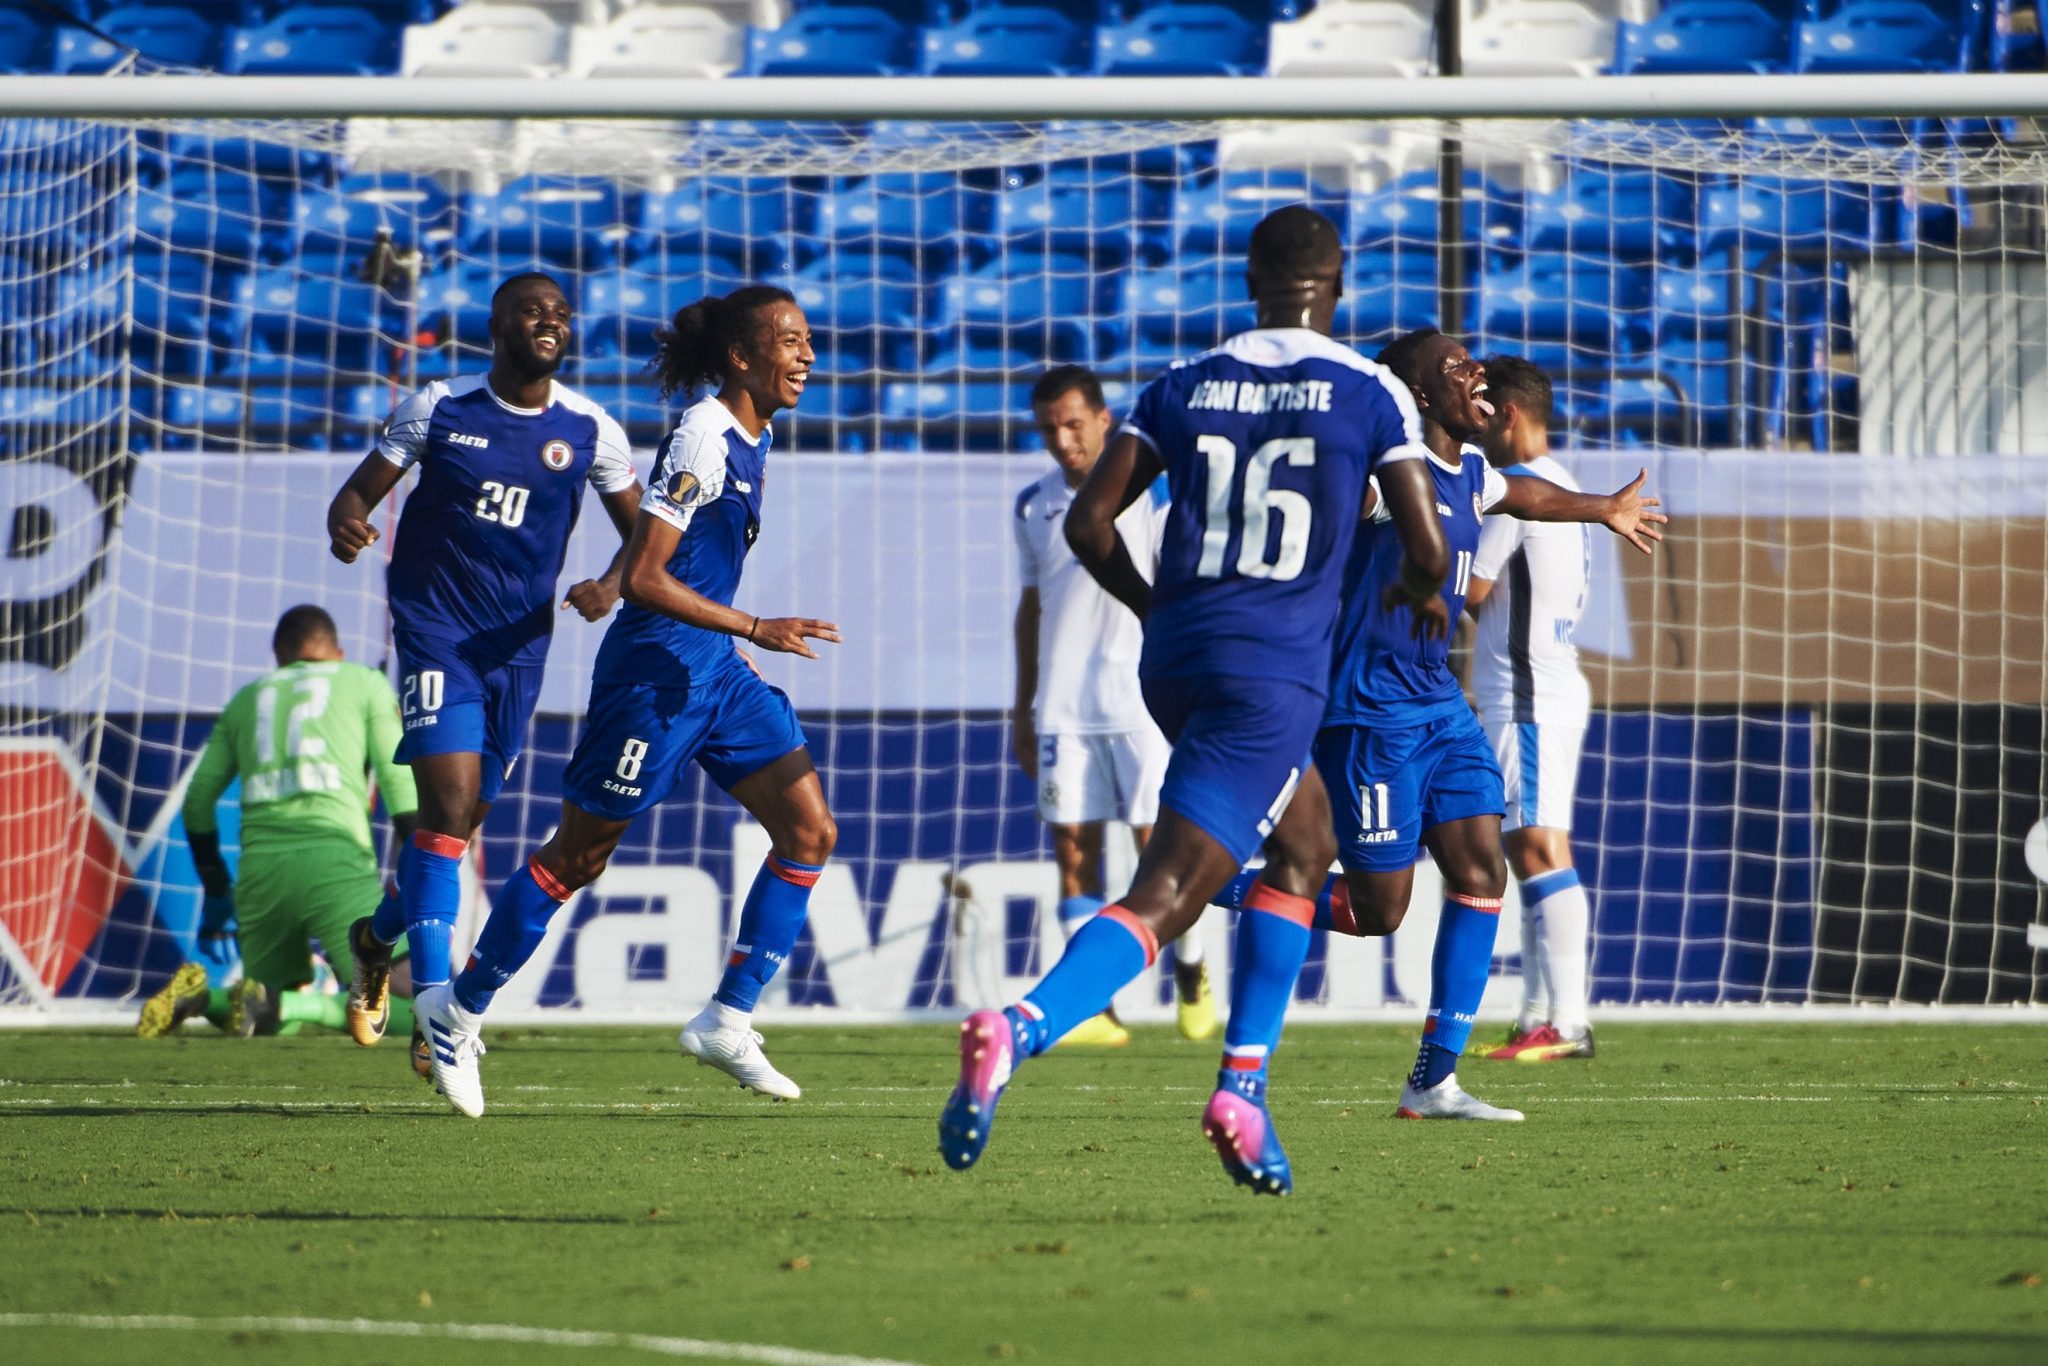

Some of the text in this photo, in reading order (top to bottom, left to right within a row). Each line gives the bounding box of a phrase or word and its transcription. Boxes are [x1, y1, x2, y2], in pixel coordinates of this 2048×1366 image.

[1187, 379, 1333, 414] JEAN BAPTISTE
[448, 433, 489, 449] SAETA
[475, 481, 531, 528] 20
[1196, 434, 1316, 581] 16
[1454, 551, 1472, 596] 11
[403, 670, 445, 717] 20
[256, 677, 331, 765] 12
[406, 714, 438, 730] SAETA
[616, 738, 649, 781] 8
[602, 779, 642, 797] SAETA
[1358, 783, 1389, 829] 11
[1357, 829, 1398, 843] SAETA
